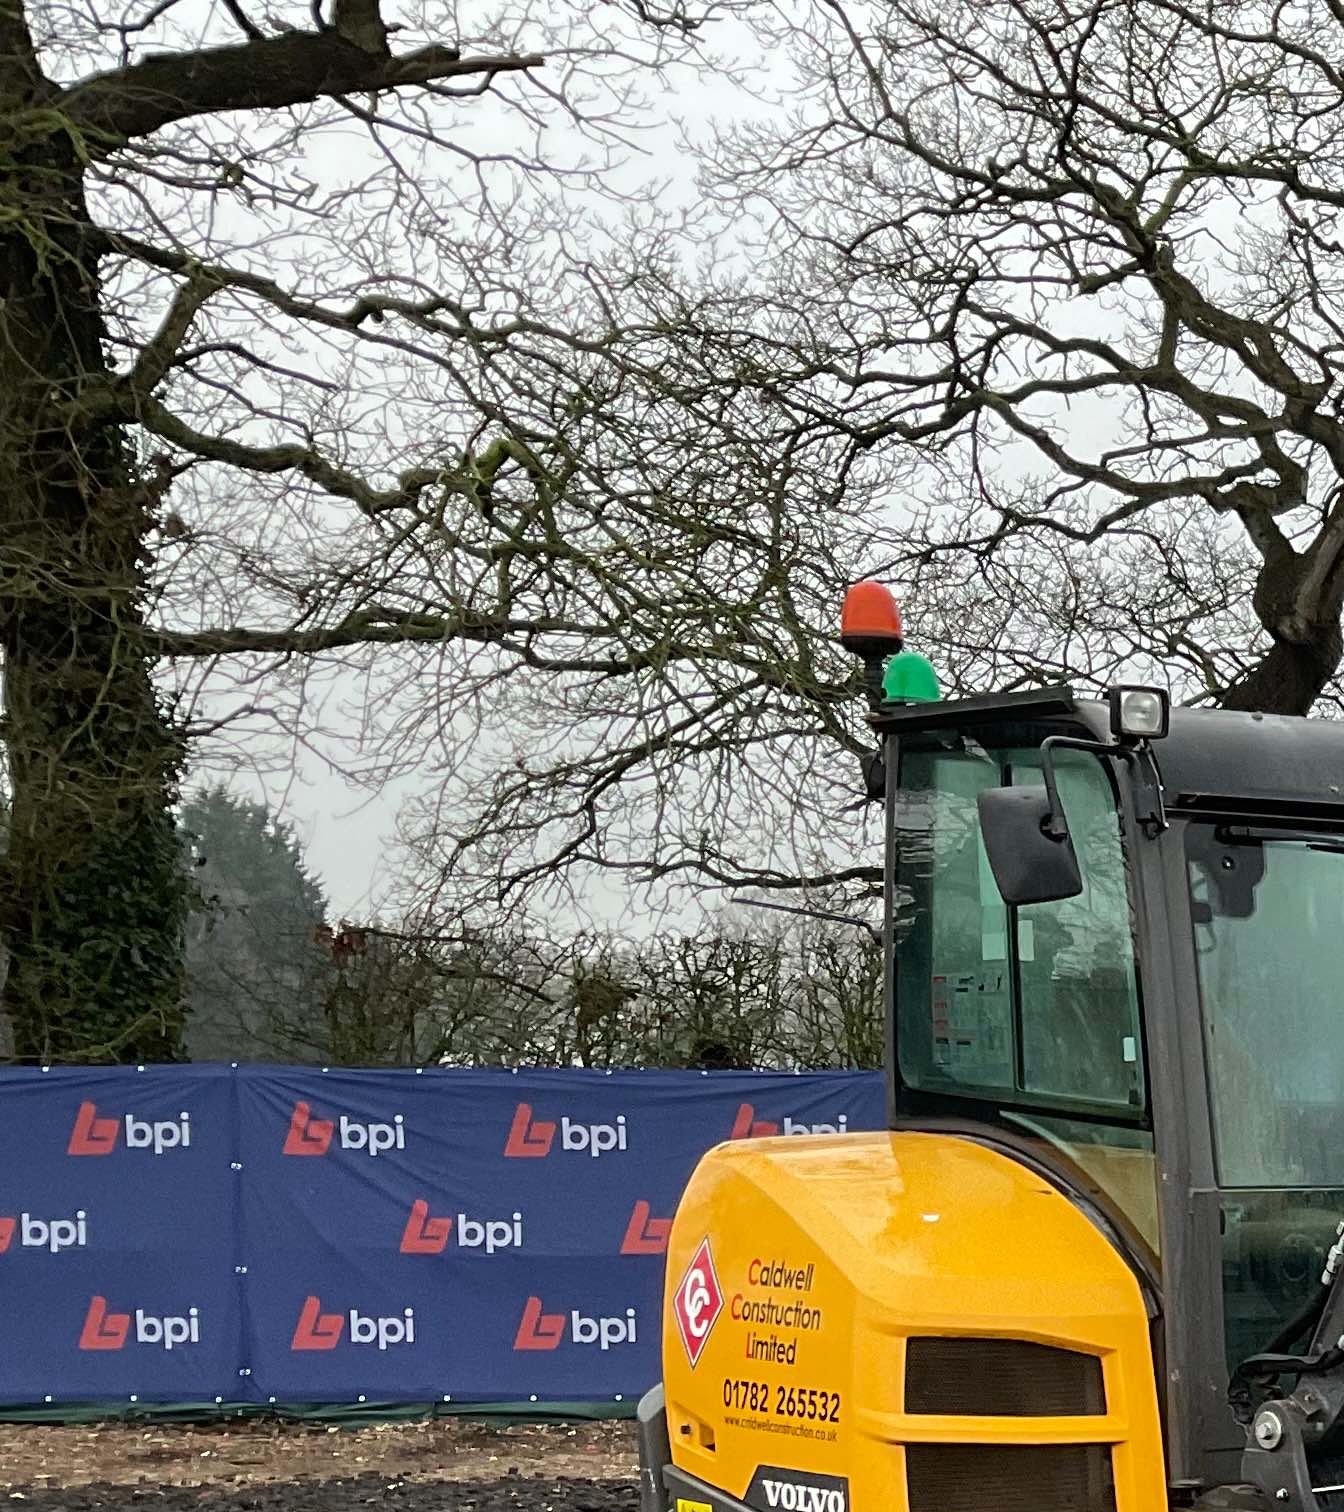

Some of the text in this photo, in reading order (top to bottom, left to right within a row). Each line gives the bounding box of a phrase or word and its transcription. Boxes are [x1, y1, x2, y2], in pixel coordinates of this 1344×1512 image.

[125, 1111, 190, 1154] bpi
[340, 1114, 405, 1156] bpi
[561, 1115, 627, 1157] bpi
[21, 1210, 86, 1253] bpi
[457, 1212, 522, 1254] bpi
[748, 1258, 815, 1292] Caldwell
[135, 1307, 199, 1350] bpi
[349, 1308, 414, 1350] bpi
[571, 1308, 636, 1350] bpi
[731, 1293, 822, 1330] Construction
[746, 1332, 797, 1365] Limited
[723, 1379, 841, 1423] 01782 265532
